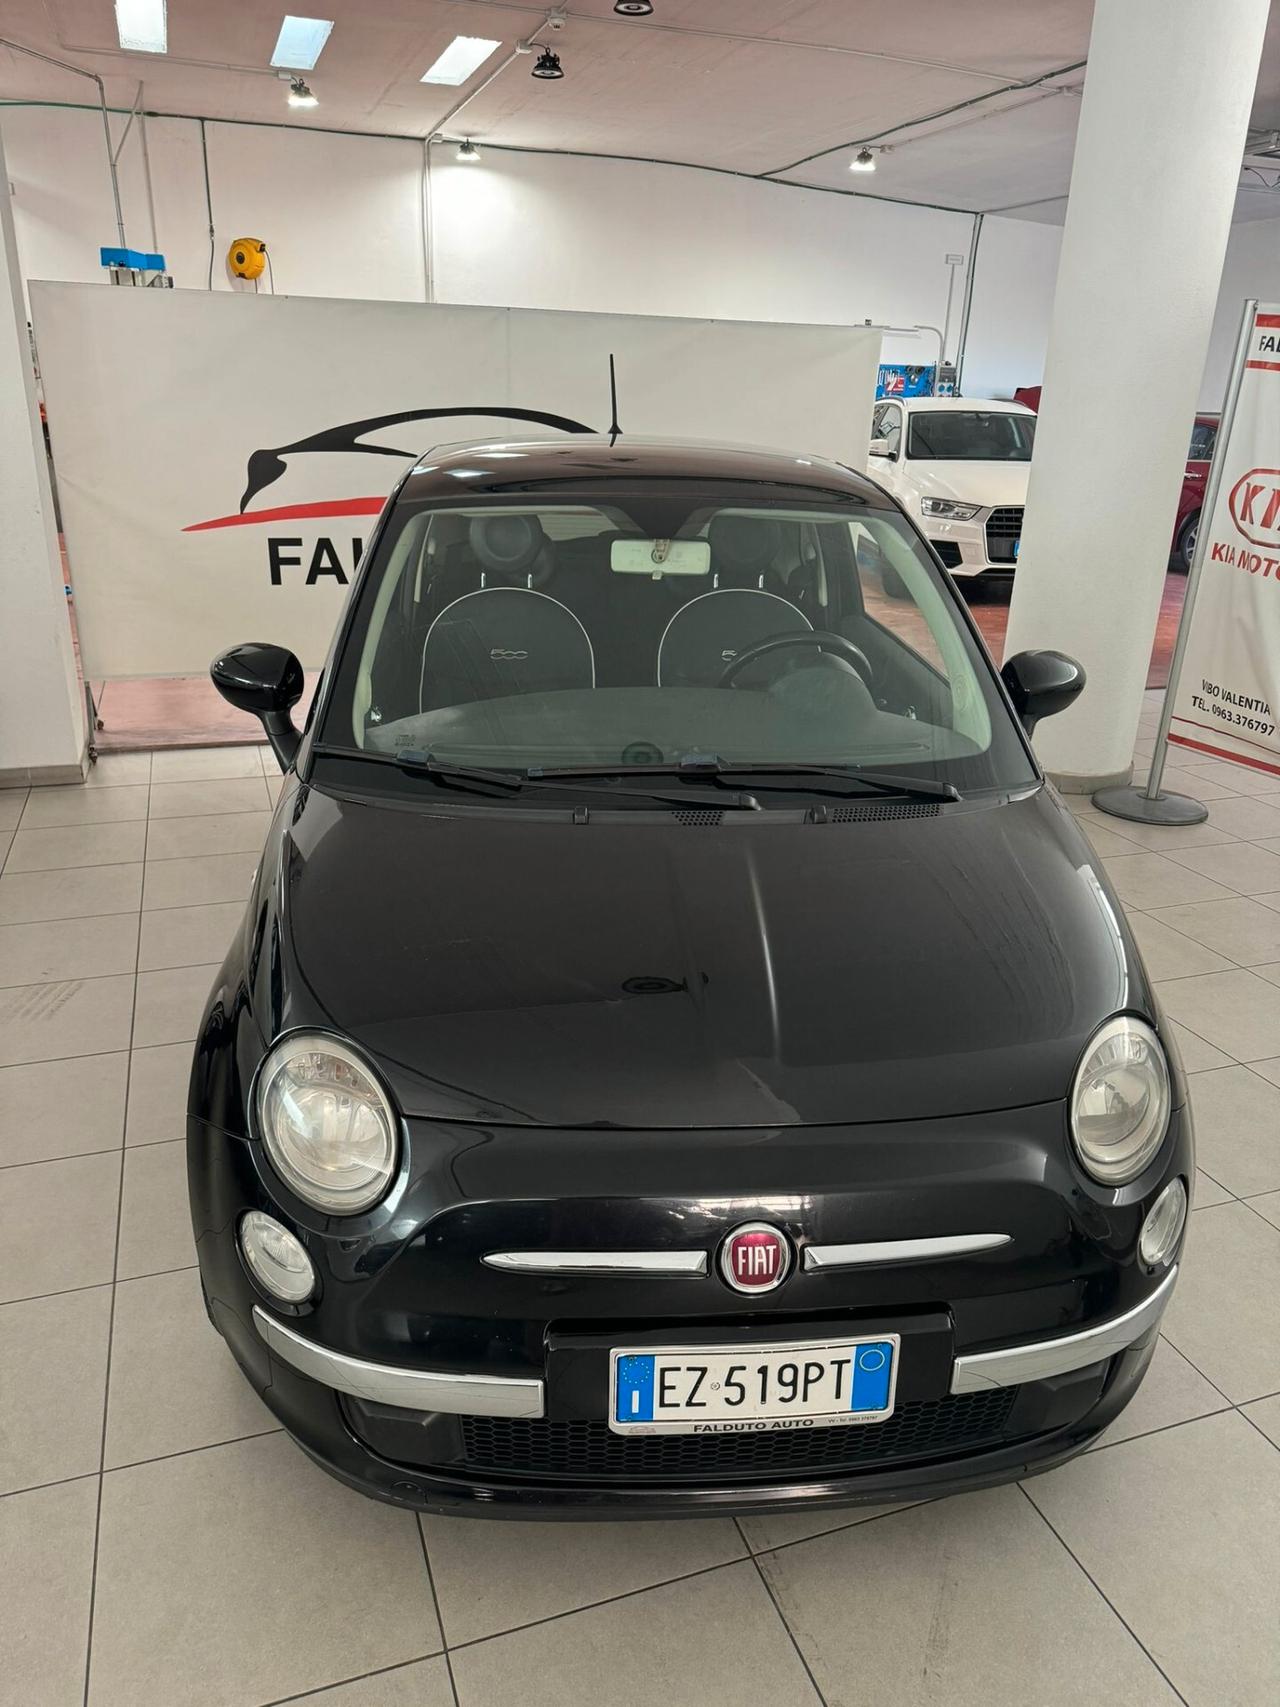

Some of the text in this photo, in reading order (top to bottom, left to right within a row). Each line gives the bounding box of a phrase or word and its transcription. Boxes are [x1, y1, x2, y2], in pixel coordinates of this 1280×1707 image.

[1210, 542, 1236, 566] KIA
[1191, 695, 1276, 737] TEL. 0963.376797
[1221, 688, 1271, 716] VALENTIA
[737, 1245, 777, 1276] FIAT
[658, 1359, 852, 1409] EZ 519PT
[693, 1421, 767, 1434] FALDUTO
[770, 1418, 815, 1430] AUTO
